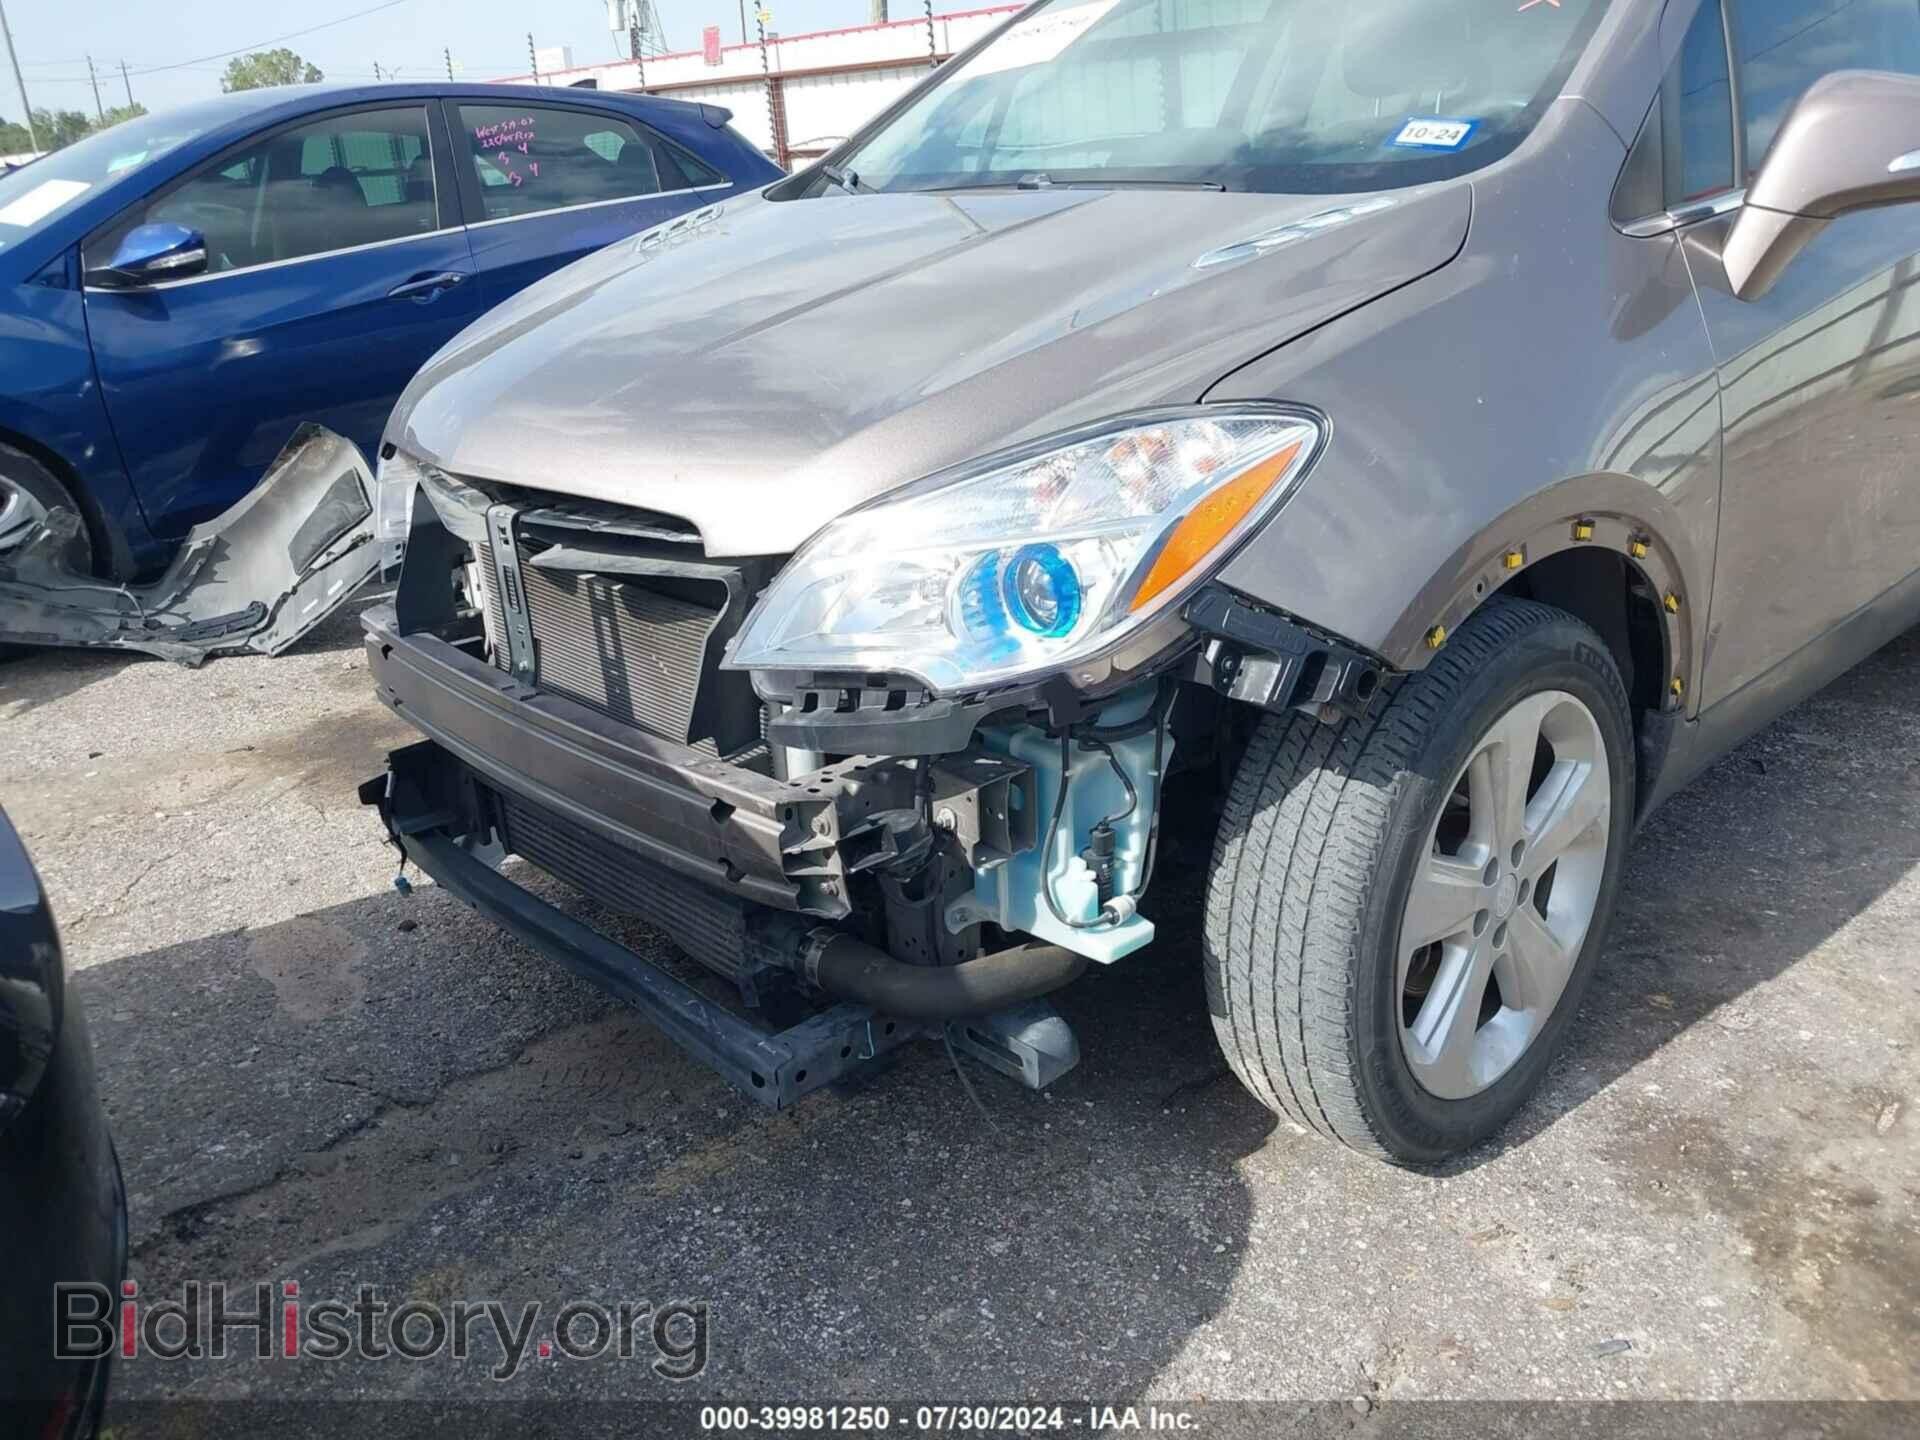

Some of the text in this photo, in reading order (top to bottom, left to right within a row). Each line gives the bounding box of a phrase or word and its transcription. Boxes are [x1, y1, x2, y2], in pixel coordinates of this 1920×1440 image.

[1404, 126, 1461, 141] 10-24
[517, 142, 529, 154] 4
[529, 162, 539, 176] 4
